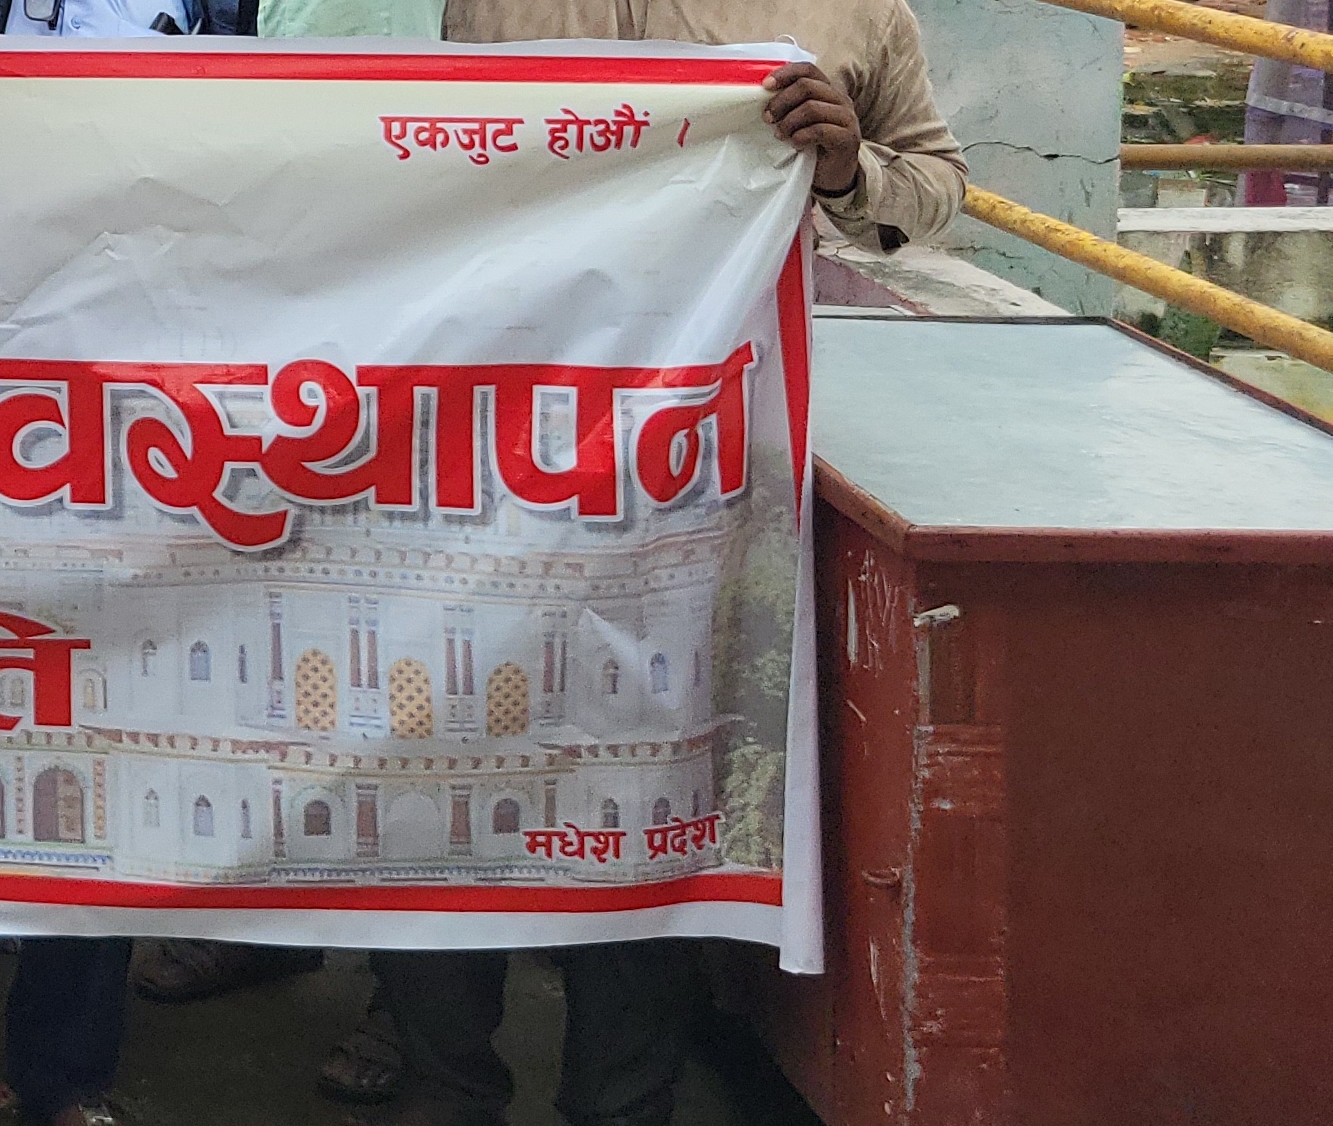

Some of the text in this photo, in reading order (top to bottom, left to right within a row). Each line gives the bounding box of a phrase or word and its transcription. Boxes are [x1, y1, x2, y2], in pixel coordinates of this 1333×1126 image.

[378, 115, 525, 166] एकजुट
[522, 812, 721, 864] मधेश प्रदेश
